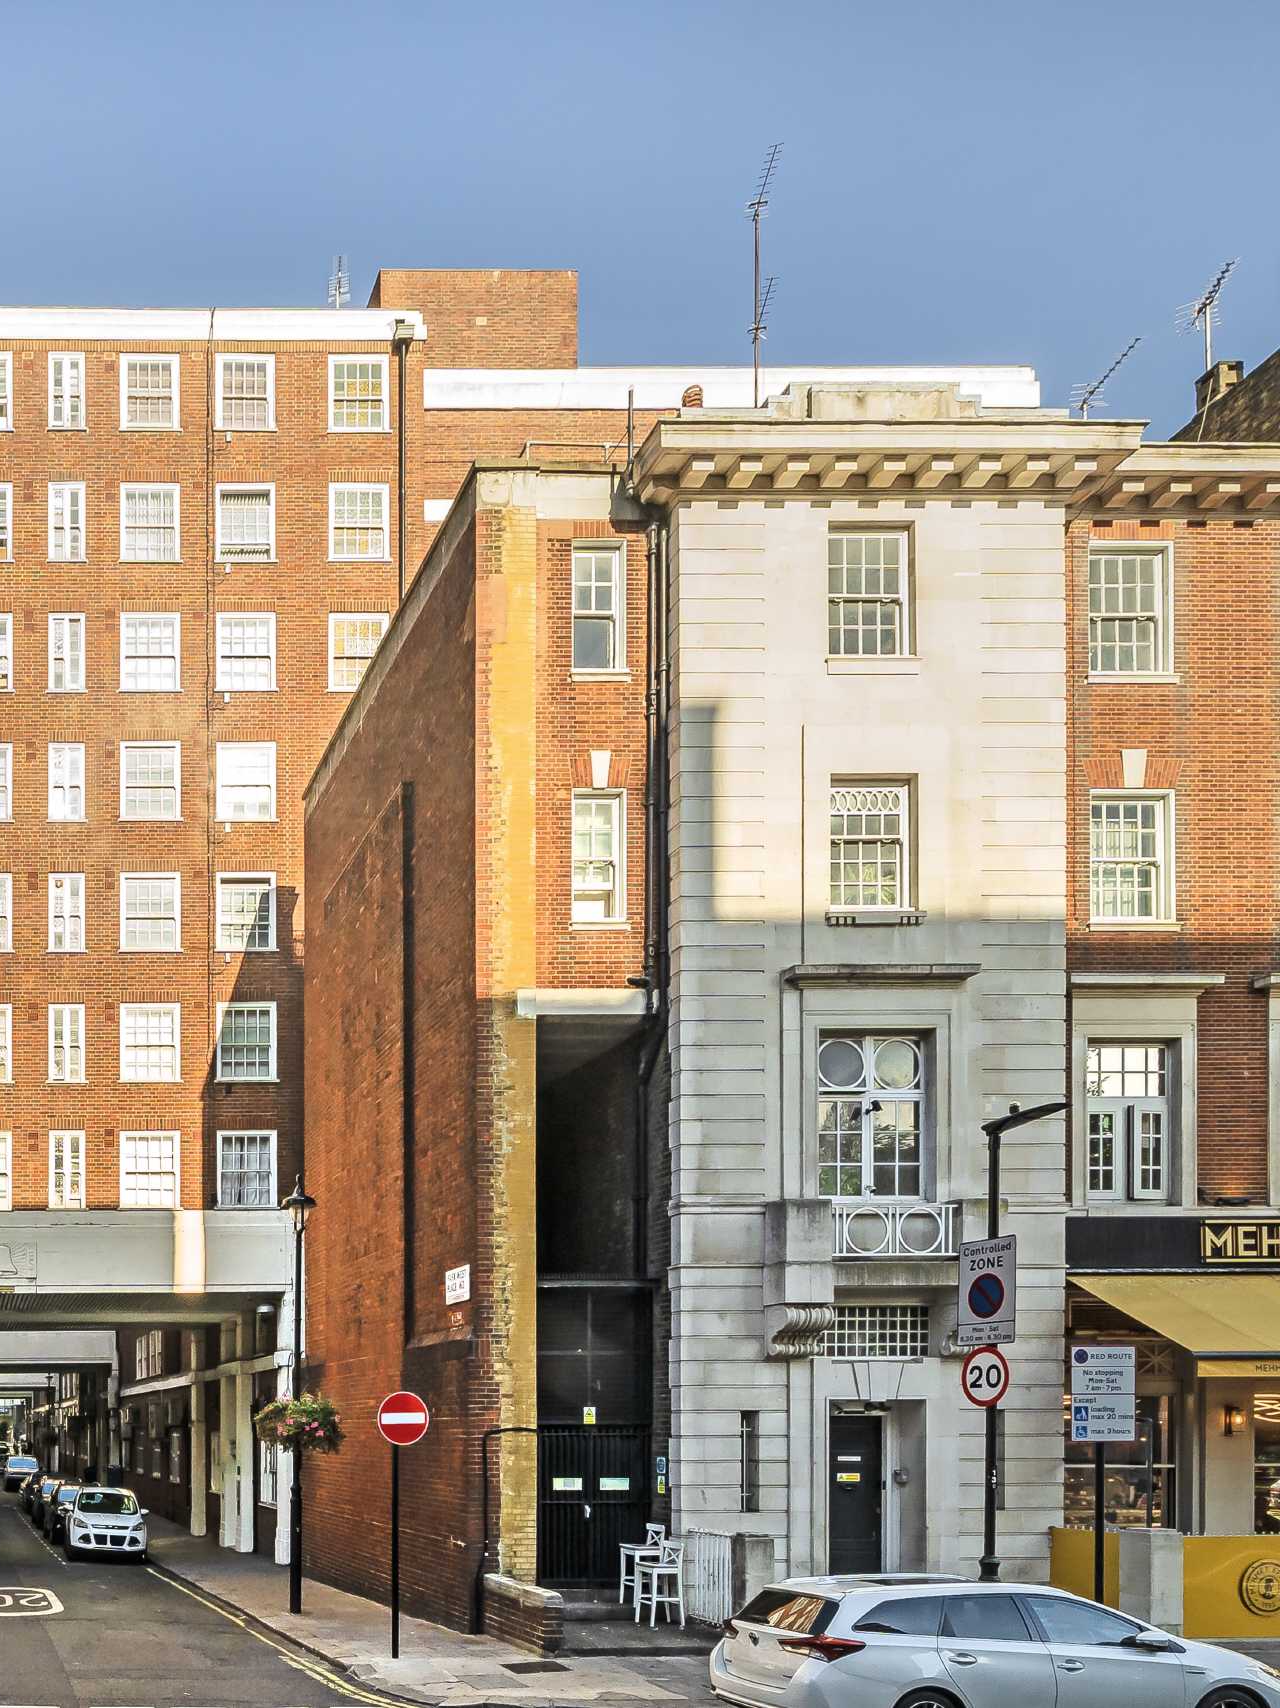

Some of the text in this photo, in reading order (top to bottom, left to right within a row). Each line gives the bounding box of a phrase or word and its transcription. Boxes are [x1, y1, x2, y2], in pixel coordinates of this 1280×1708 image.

[963, 1241, 1012, 1257] Controlled
[969, 1256, 1004, 1271] ZONE
[969, 1364, 1002, 1389] 20
